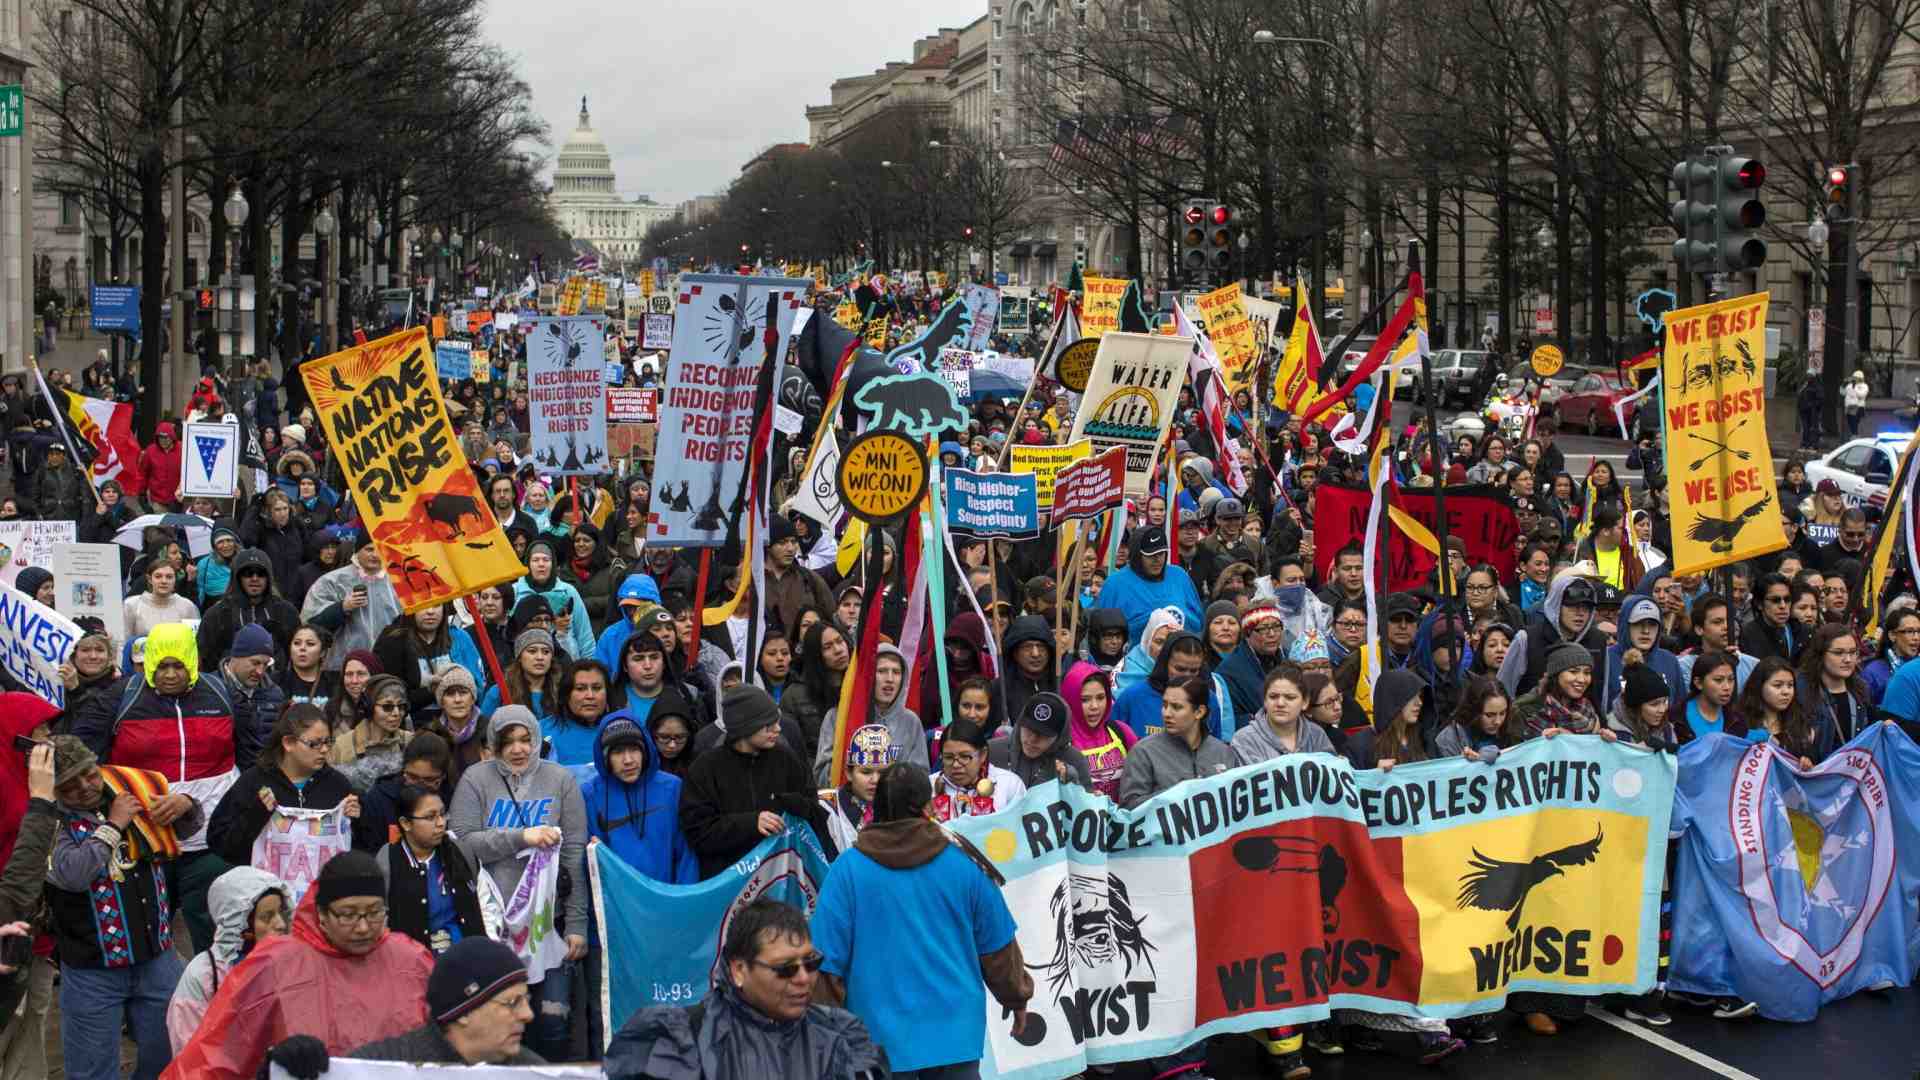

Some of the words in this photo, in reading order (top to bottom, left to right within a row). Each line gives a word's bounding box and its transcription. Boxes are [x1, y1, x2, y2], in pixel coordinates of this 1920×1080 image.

[1672, 319, 1701, 346] WE
[1706, 305, 1761, 338] EXIST
[535, 368, 601, 386] RECOGNIZE
[1111, 364, 1172, 390] WATER
[332, 347, 427, 445] NATIVE
[530, 385, 602, 402] INDIGENOUS
[1107, 402, 1149, 425] LIFE
[1668, 402, 1702, 432] WE
[1705, 386, 1765, 425] RSIST
[346, 388, 439, 477] NATIONS
[547, 417, 590, 433] RIGHTS
[358, 419, 451, 516] RISE
[865, 452, 897, 471] MNI
[848, 471, 913, 493] WICONI
[954, 477, 976, 494] Rise
[1684, 477, 1718, 505] WE
[957, 507, 1027, 528] Sovereignty
[967, 494, 1014, 512] Respect
[0, 593, 73, 664] NVEST
[0, 638, 64, 708] LEAN
[487, 798, 553, 828] NIKE
[1156, 760, 1361, 846] INDIGENOUS
[1360, 774, 1489, 828] EOPLES
[1495, 760, 1601, 811] RIGHTS
[1738, 780, 1758, 854] STANDING
[1861, 768, 1884, 811] TRIBE
[1216, 951, 1293, 1012] WE
